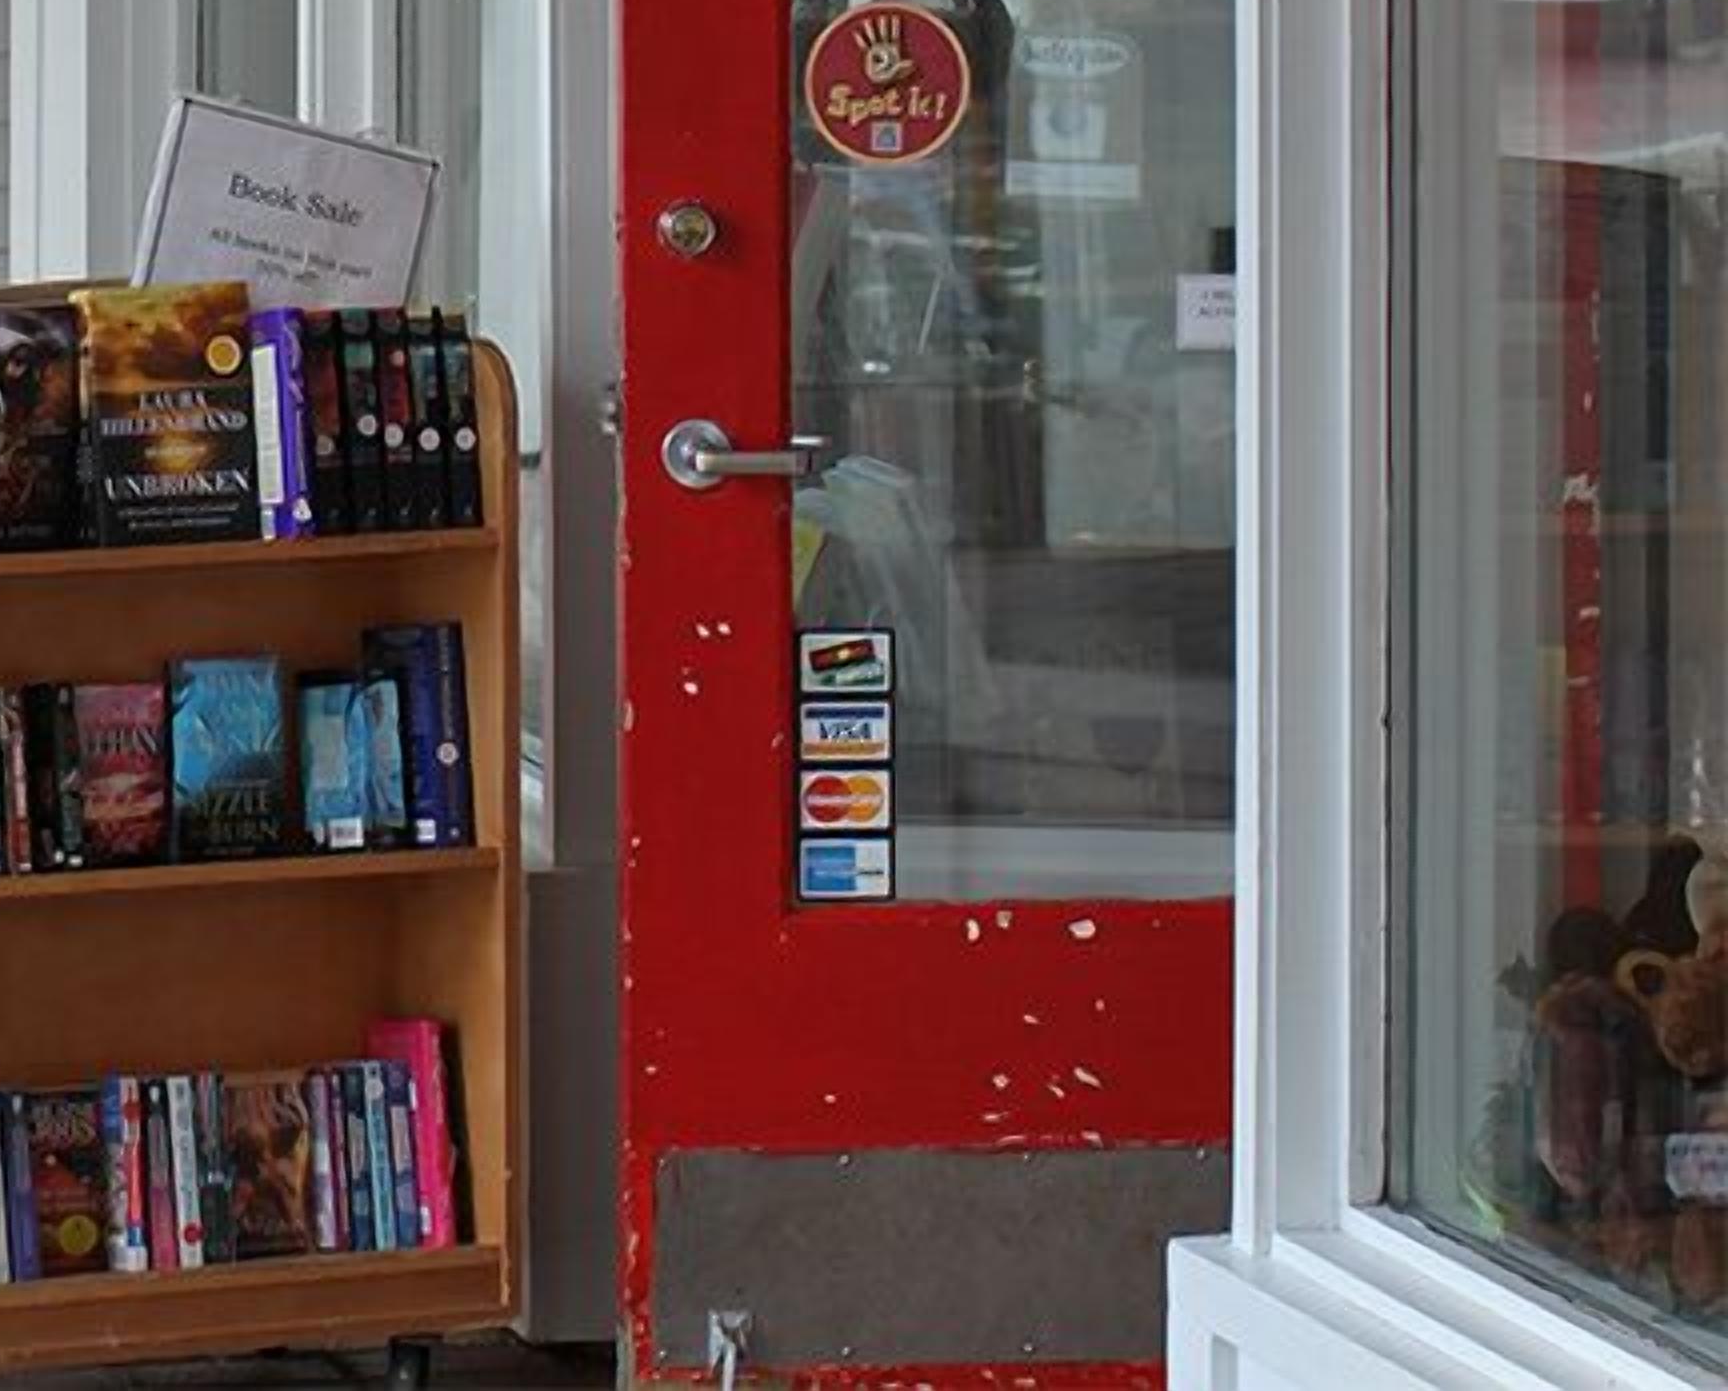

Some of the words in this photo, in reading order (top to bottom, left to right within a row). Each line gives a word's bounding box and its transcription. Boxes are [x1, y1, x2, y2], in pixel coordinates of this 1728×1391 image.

[827, 83, 904, 127] Spot
[228, 172, 297, 212] Book
[304, 192, 362, 227] Sale
